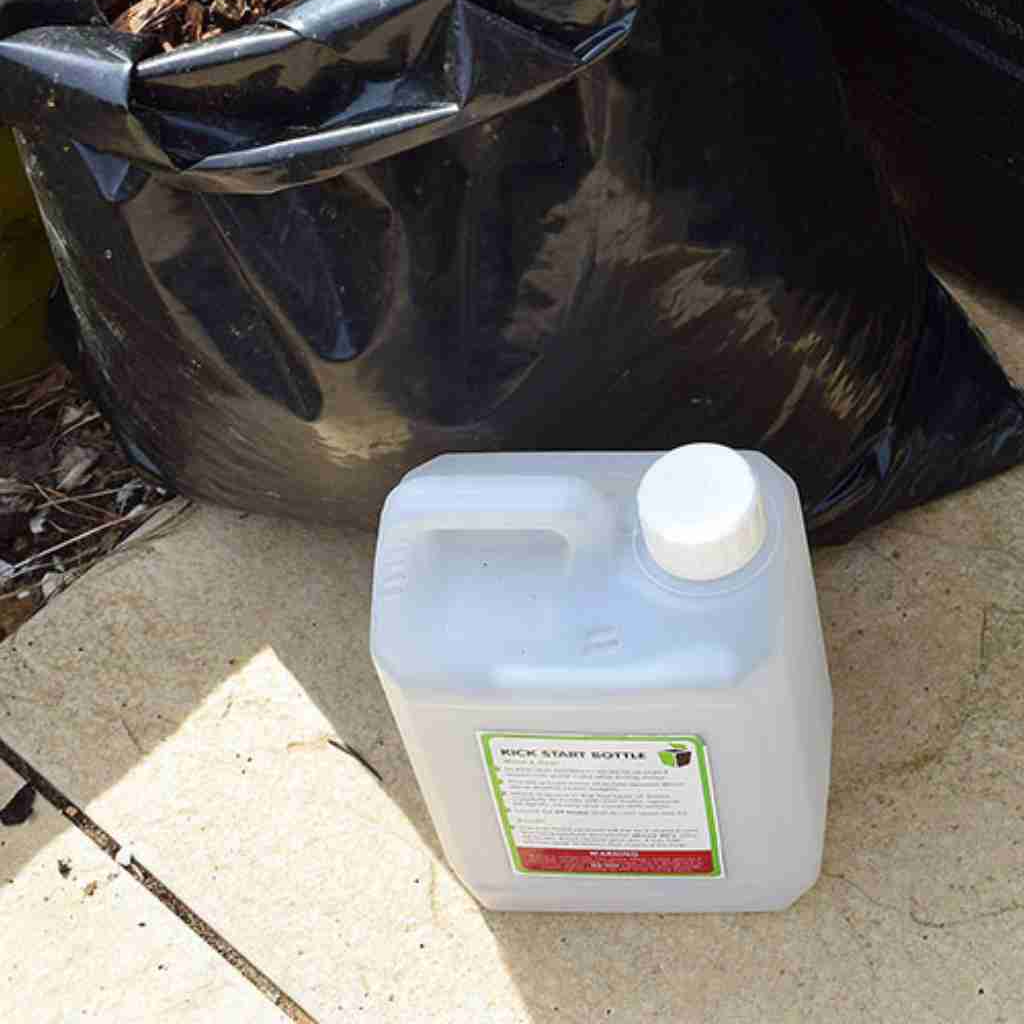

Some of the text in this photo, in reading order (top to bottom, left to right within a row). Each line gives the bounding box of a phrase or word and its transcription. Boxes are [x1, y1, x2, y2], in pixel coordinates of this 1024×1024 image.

[500, 748, 647, 761] KICK START BOTTLE
